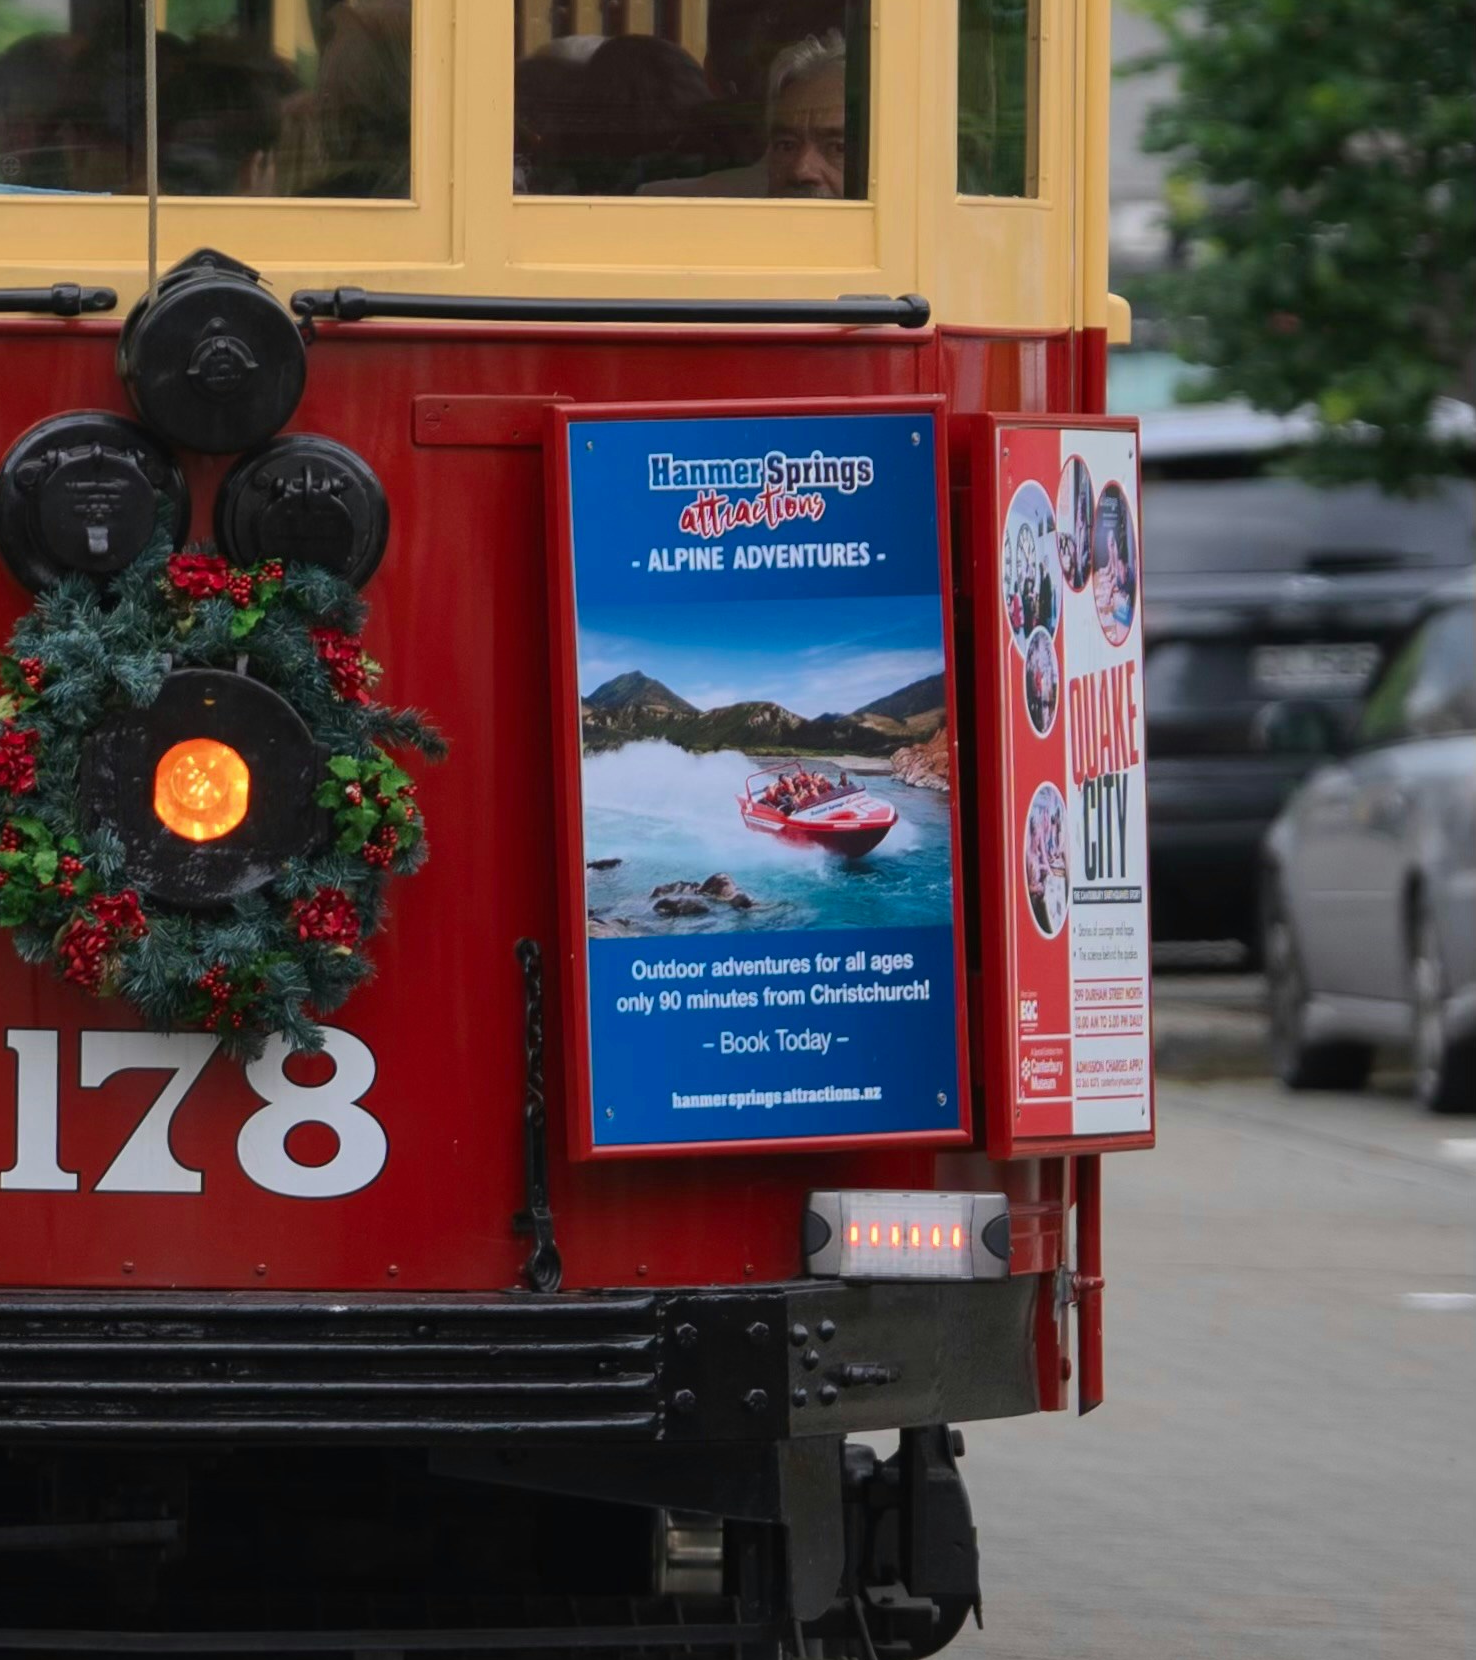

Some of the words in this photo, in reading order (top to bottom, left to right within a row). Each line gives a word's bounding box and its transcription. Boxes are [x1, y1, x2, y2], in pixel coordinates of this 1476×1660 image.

[649, 453, 762, 490] Hanmer
[763, 450, 873, 494] Springs
[678, 482, 826, 539] attractions
[648, 546, 725, 572] ALPINE
[732, 541, 870, 570] ADVENTURES
[1069, 659, 1139, 792] QUAKE
[1083, 773, 1128, 881] CITY
[631, 959, 706, 980] Outdoor
[711, 954, 811, 978] adventures
[815, 953, 840, 973] for
[845, 951, 866, 971] all
[870, 953, 914, 975] ages
[616, 992, 654, 1015] only
[659, 990, 682, 1010] 90
[686, 988, 758, 1009] minutes
[763, 986, 805, 1007] from
[810, 979, 930, 1005] Christchurch!
[720, 1030, 770, 1054] Book
[775, 1027, 832, 1055] Today
